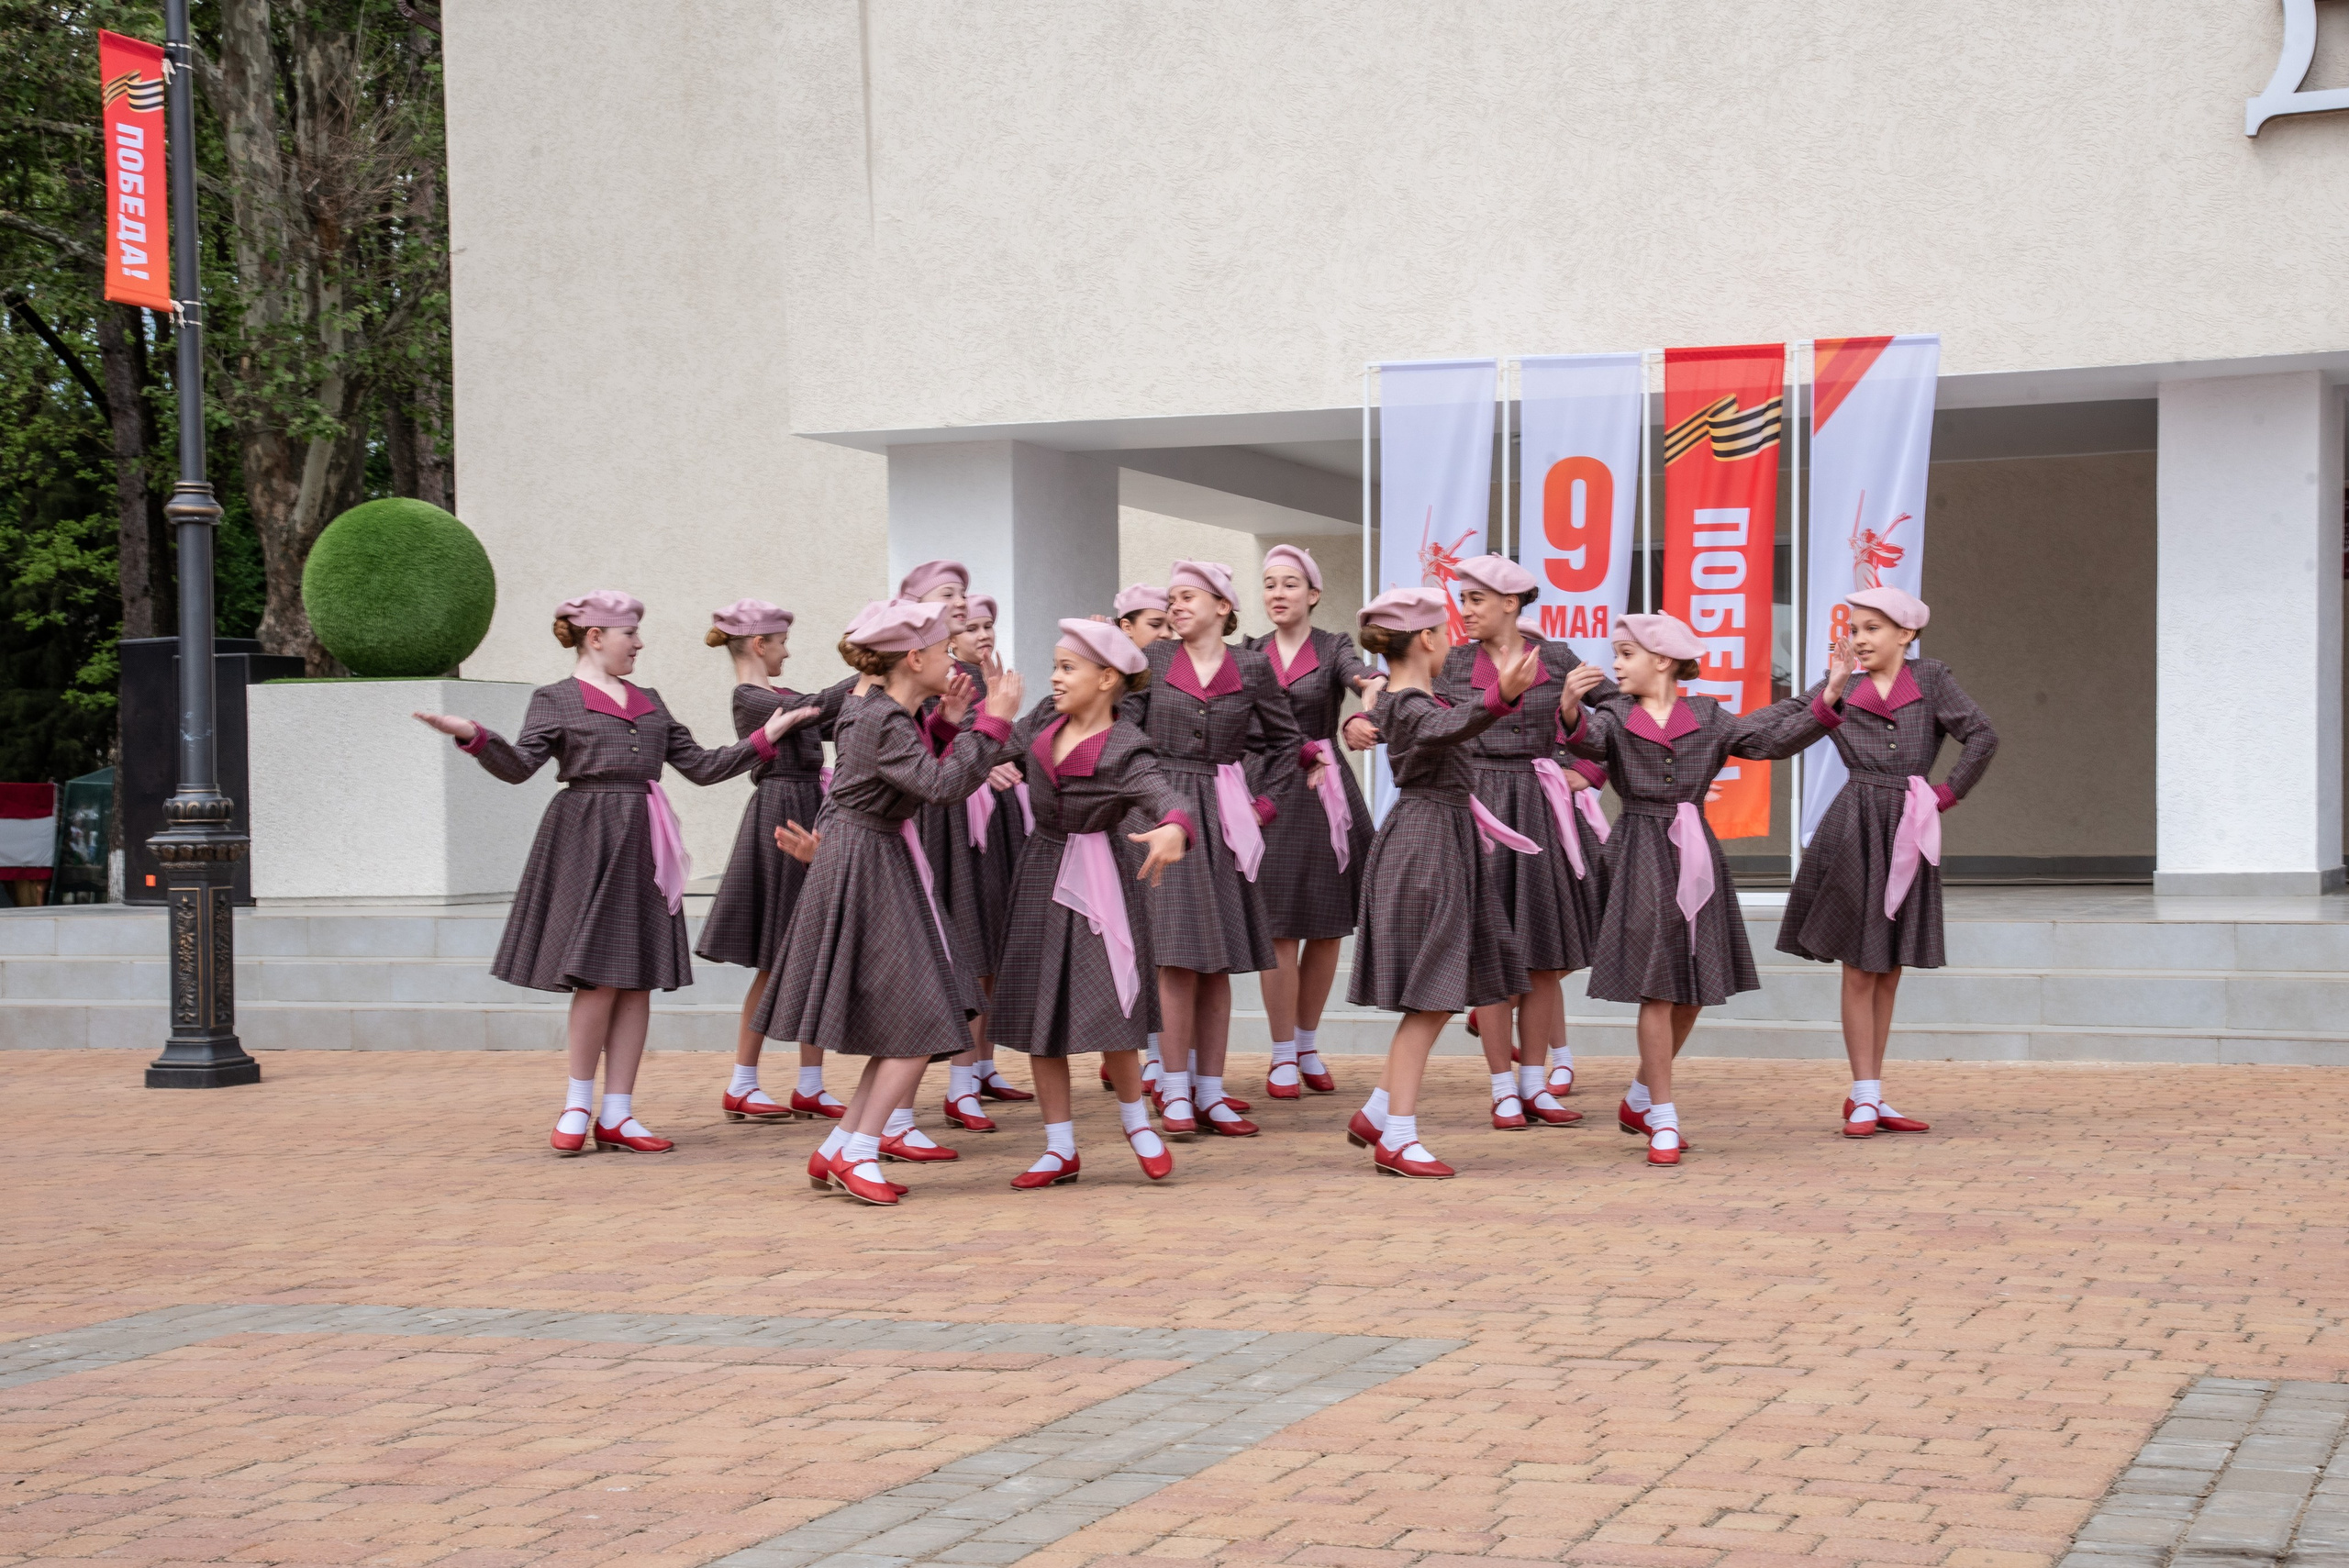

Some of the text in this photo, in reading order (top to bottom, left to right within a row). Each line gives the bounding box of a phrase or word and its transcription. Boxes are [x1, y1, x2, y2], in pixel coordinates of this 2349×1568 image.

[116, 122, 150, 280] ПОБЕДА!
[1542, 456, 1613, 593] 9
[1540, 605, 1609, 639] МАЯ
[1829, 604, 1851, 643] 8
